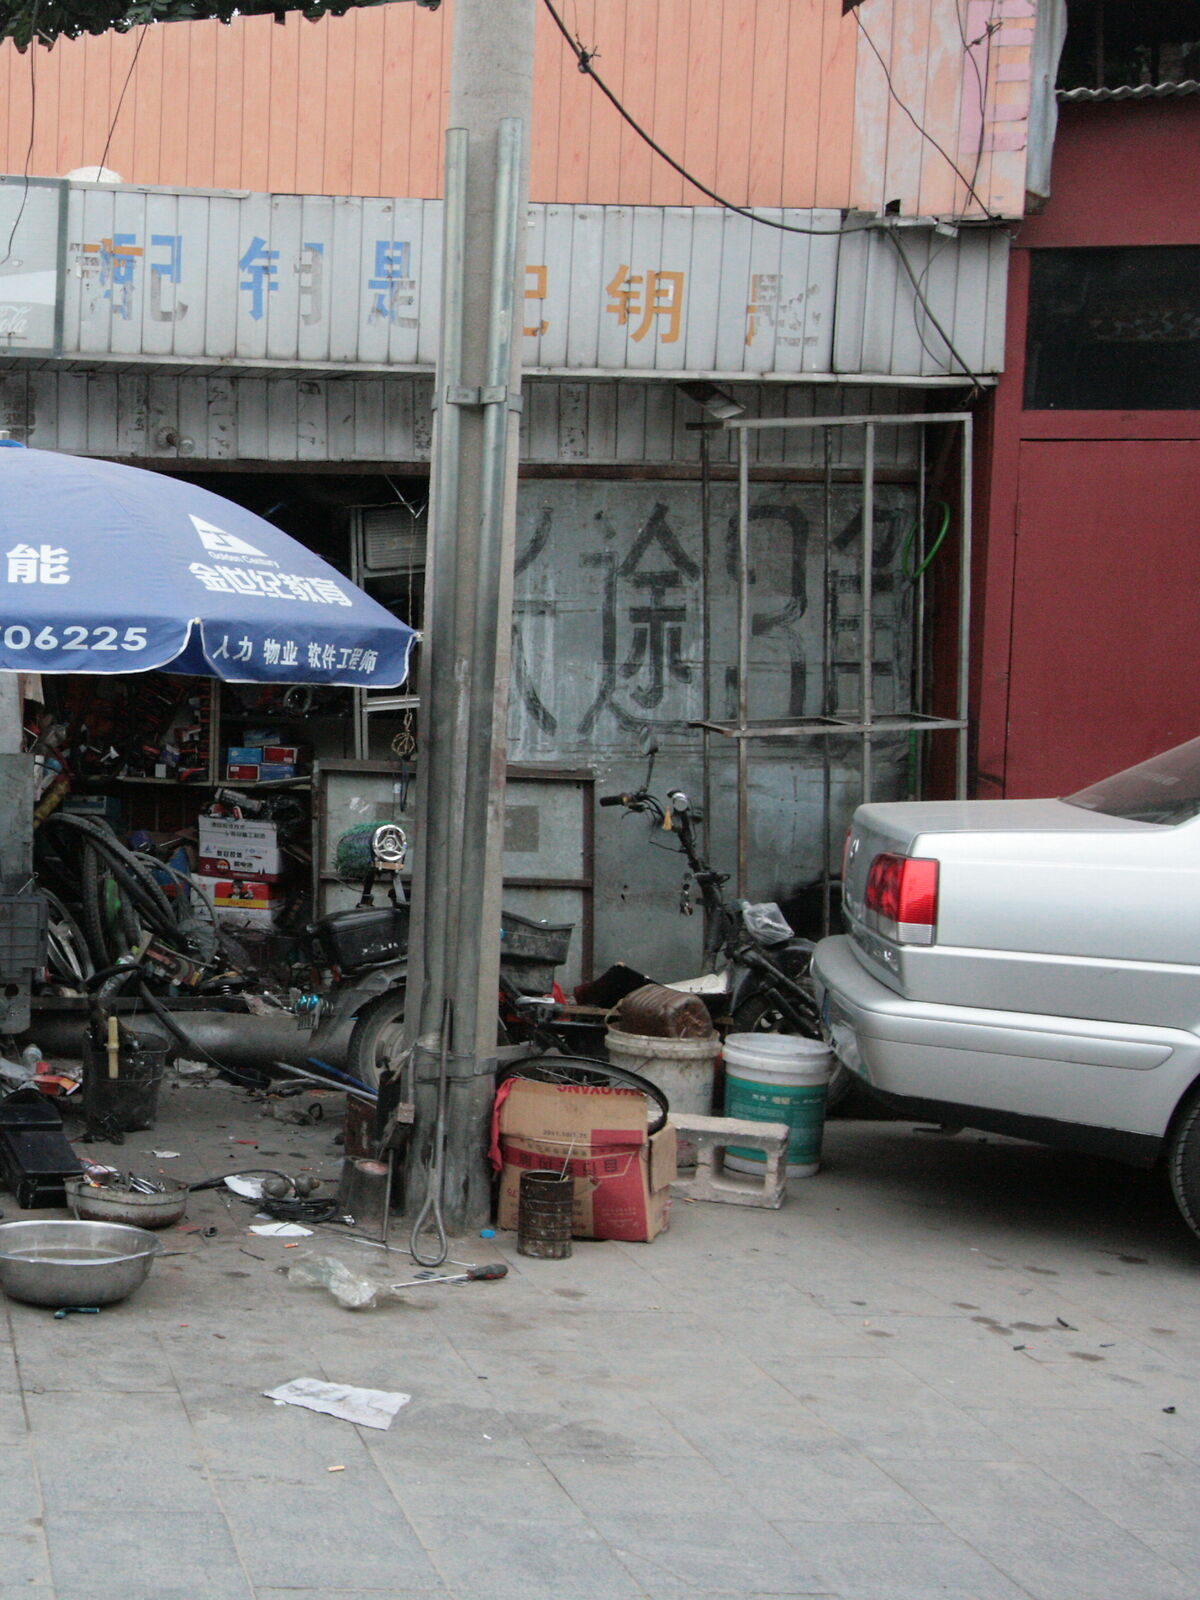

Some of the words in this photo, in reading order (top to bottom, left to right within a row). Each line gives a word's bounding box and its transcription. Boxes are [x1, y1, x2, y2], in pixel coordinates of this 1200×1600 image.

[187, 561, 353, 608] 金世纪教育
[212, 634, 254, 662] 人力
[263, 637, 300, 666] 物业
[307, 641, 380, 675] 软件工程师
